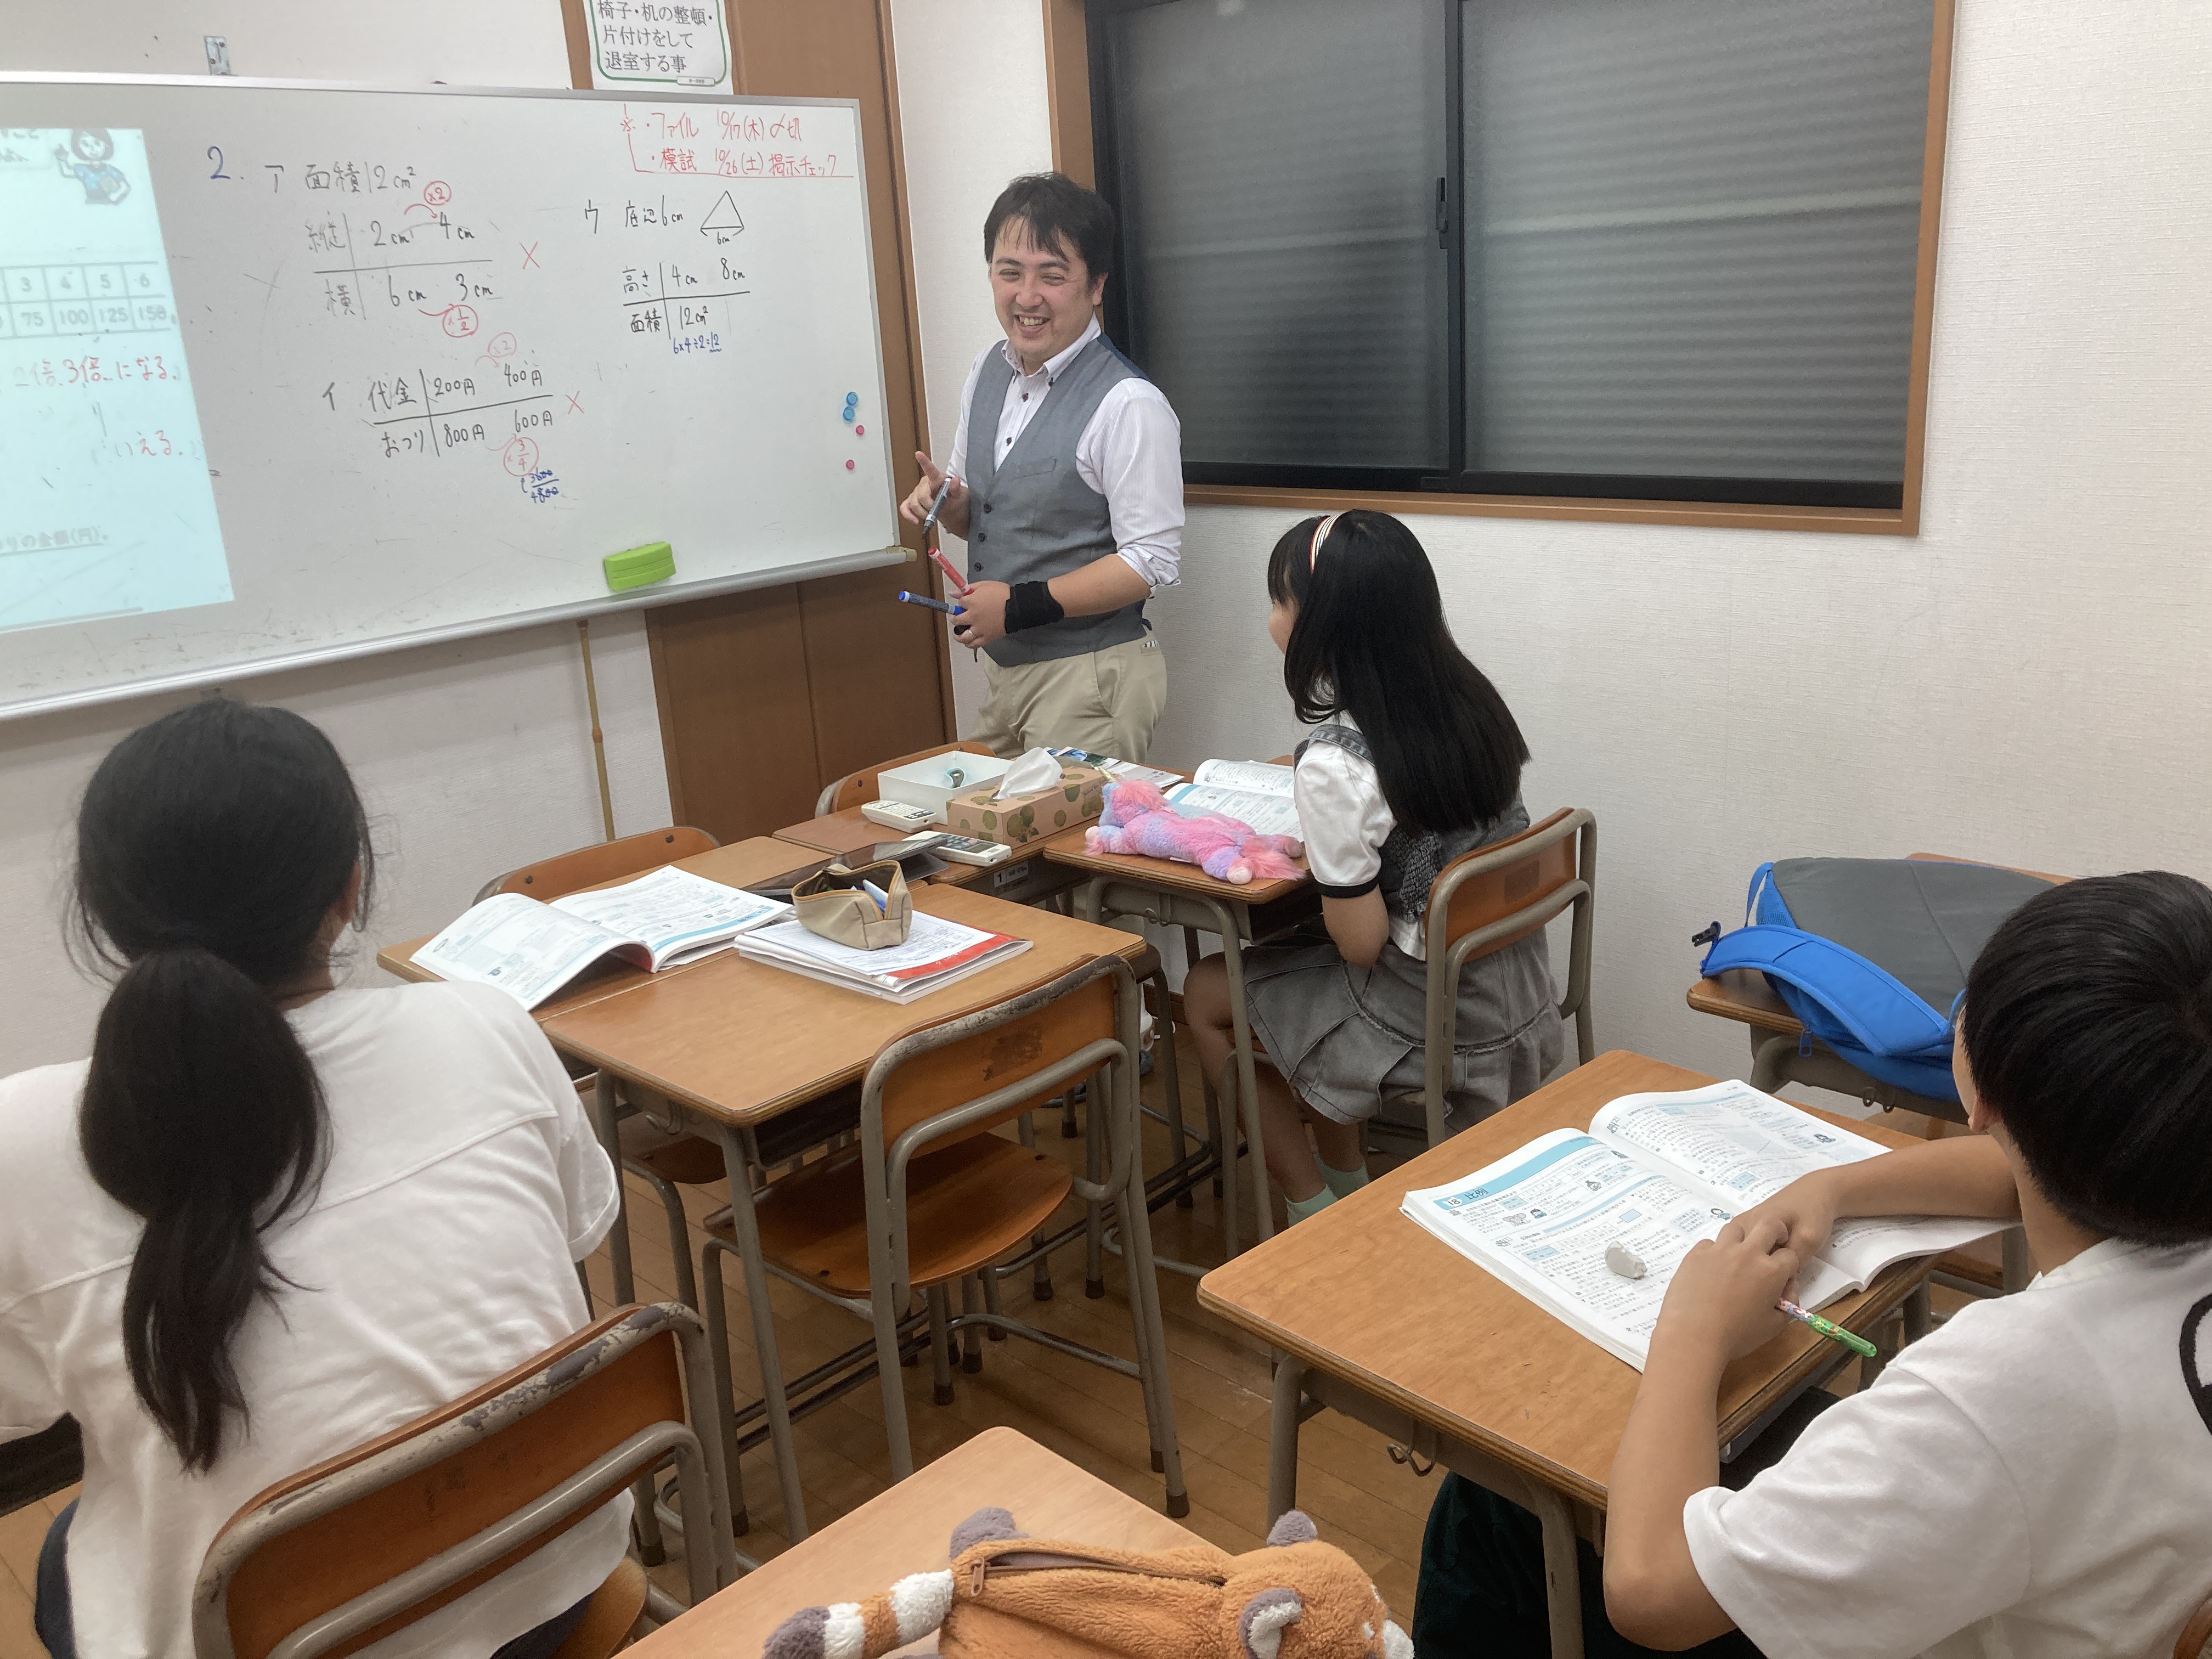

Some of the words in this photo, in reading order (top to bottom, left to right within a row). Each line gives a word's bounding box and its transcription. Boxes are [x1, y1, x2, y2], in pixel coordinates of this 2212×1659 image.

[603, 25, 693, 48] 片付けをして
[605, 50, 687, 73] 退室する事
[99, 272, 112, 290] 5
[20, 311, 44, 328] 75
[59, 308, 90, 326] 100
[98, 306, 129, 324] 125
[630, 307, 662, 332] 面積
[367, 376, 417, 413] 代金
[381, 430, 424, 458] おつり
[1464, 1187, 1489, 1201] 比例
